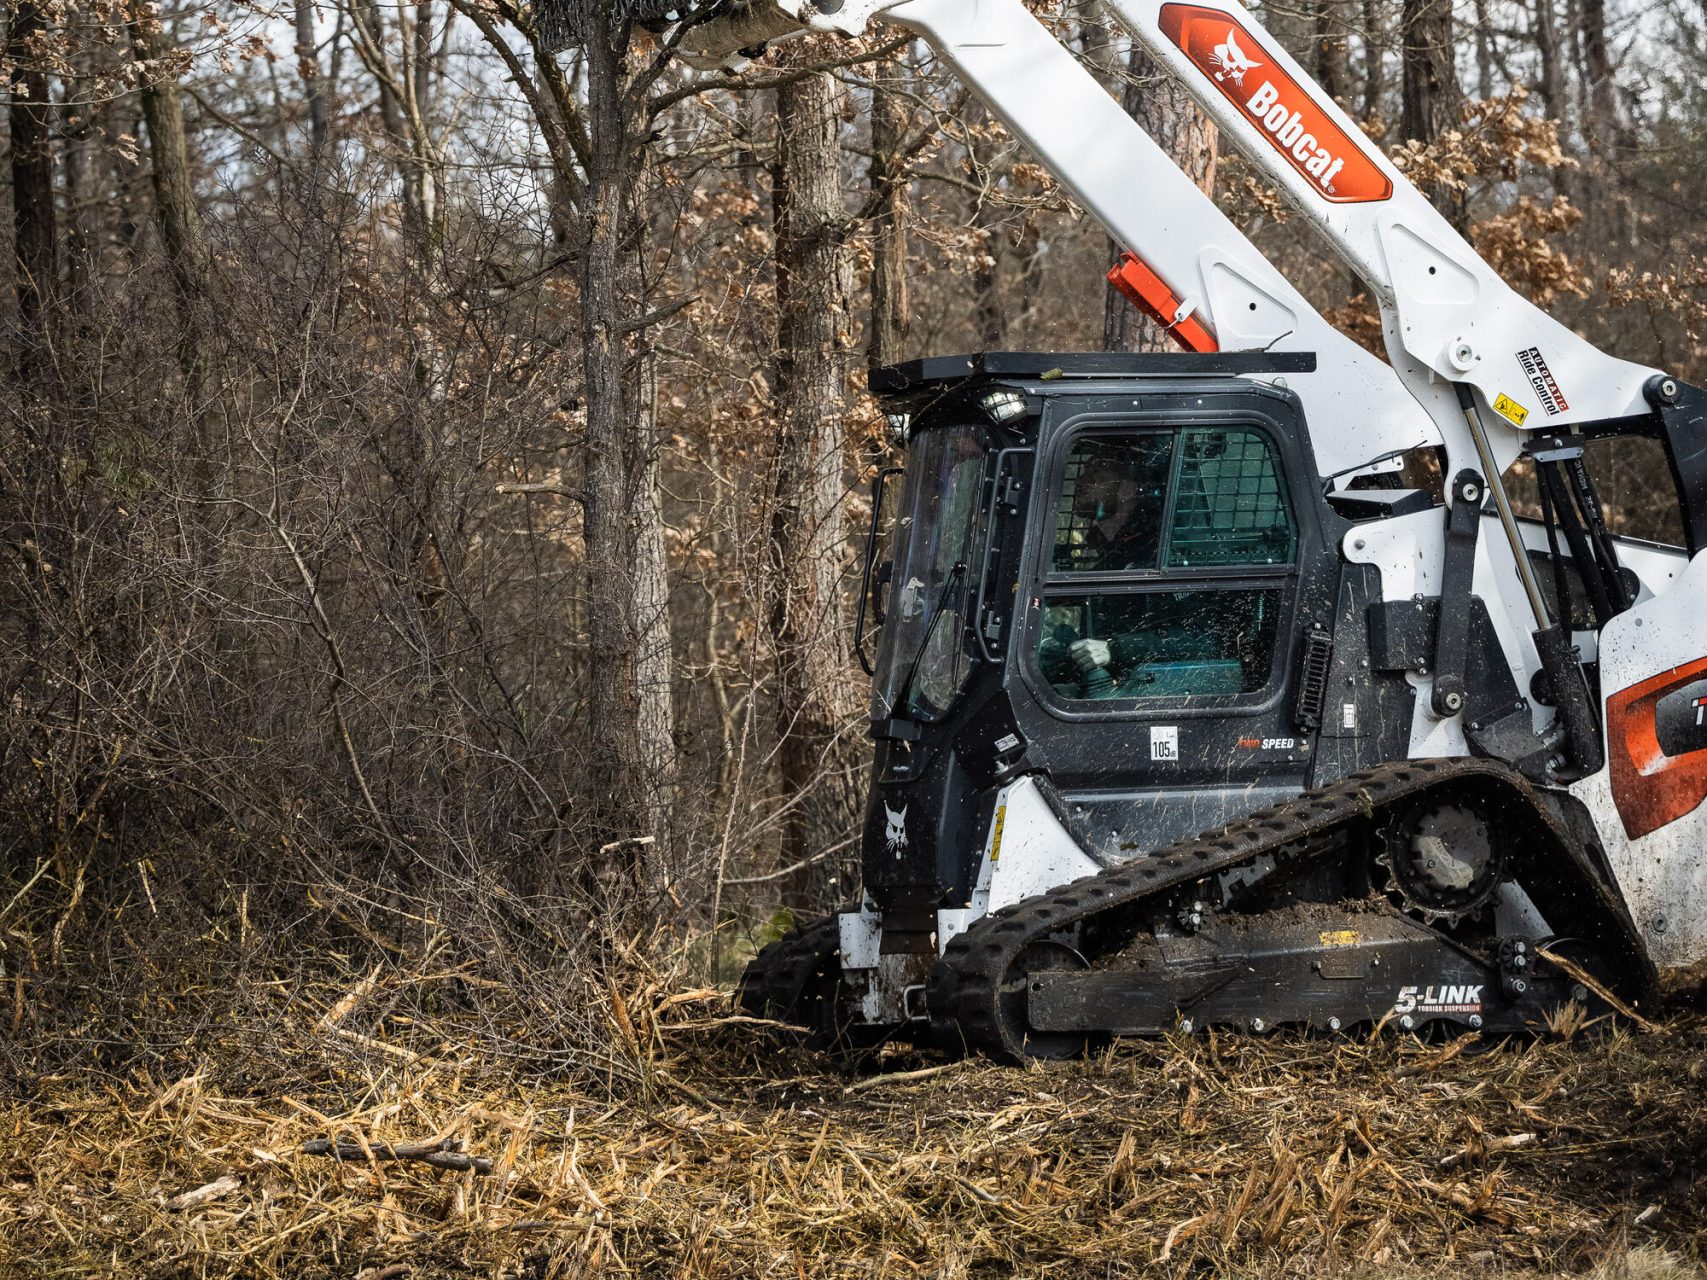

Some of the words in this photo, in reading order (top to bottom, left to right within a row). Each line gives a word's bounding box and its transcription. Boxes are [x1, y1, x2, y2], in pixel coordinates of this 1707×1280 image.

[1246, 80, 1345, 188] Bobcat
[1518, 349, 1536, 375] Ride
[1532, 376, 1560, 416] Control
[1529, 348, 1568, 411] AUTOMATIC
[1153, 740, 1170, 758] 105
[1261, 738, 1294, 749] SPEED
[1395, 985, 1484, 1012] 5-LINK
[1444, 1004, 1480, 1012] SUSPENSION
